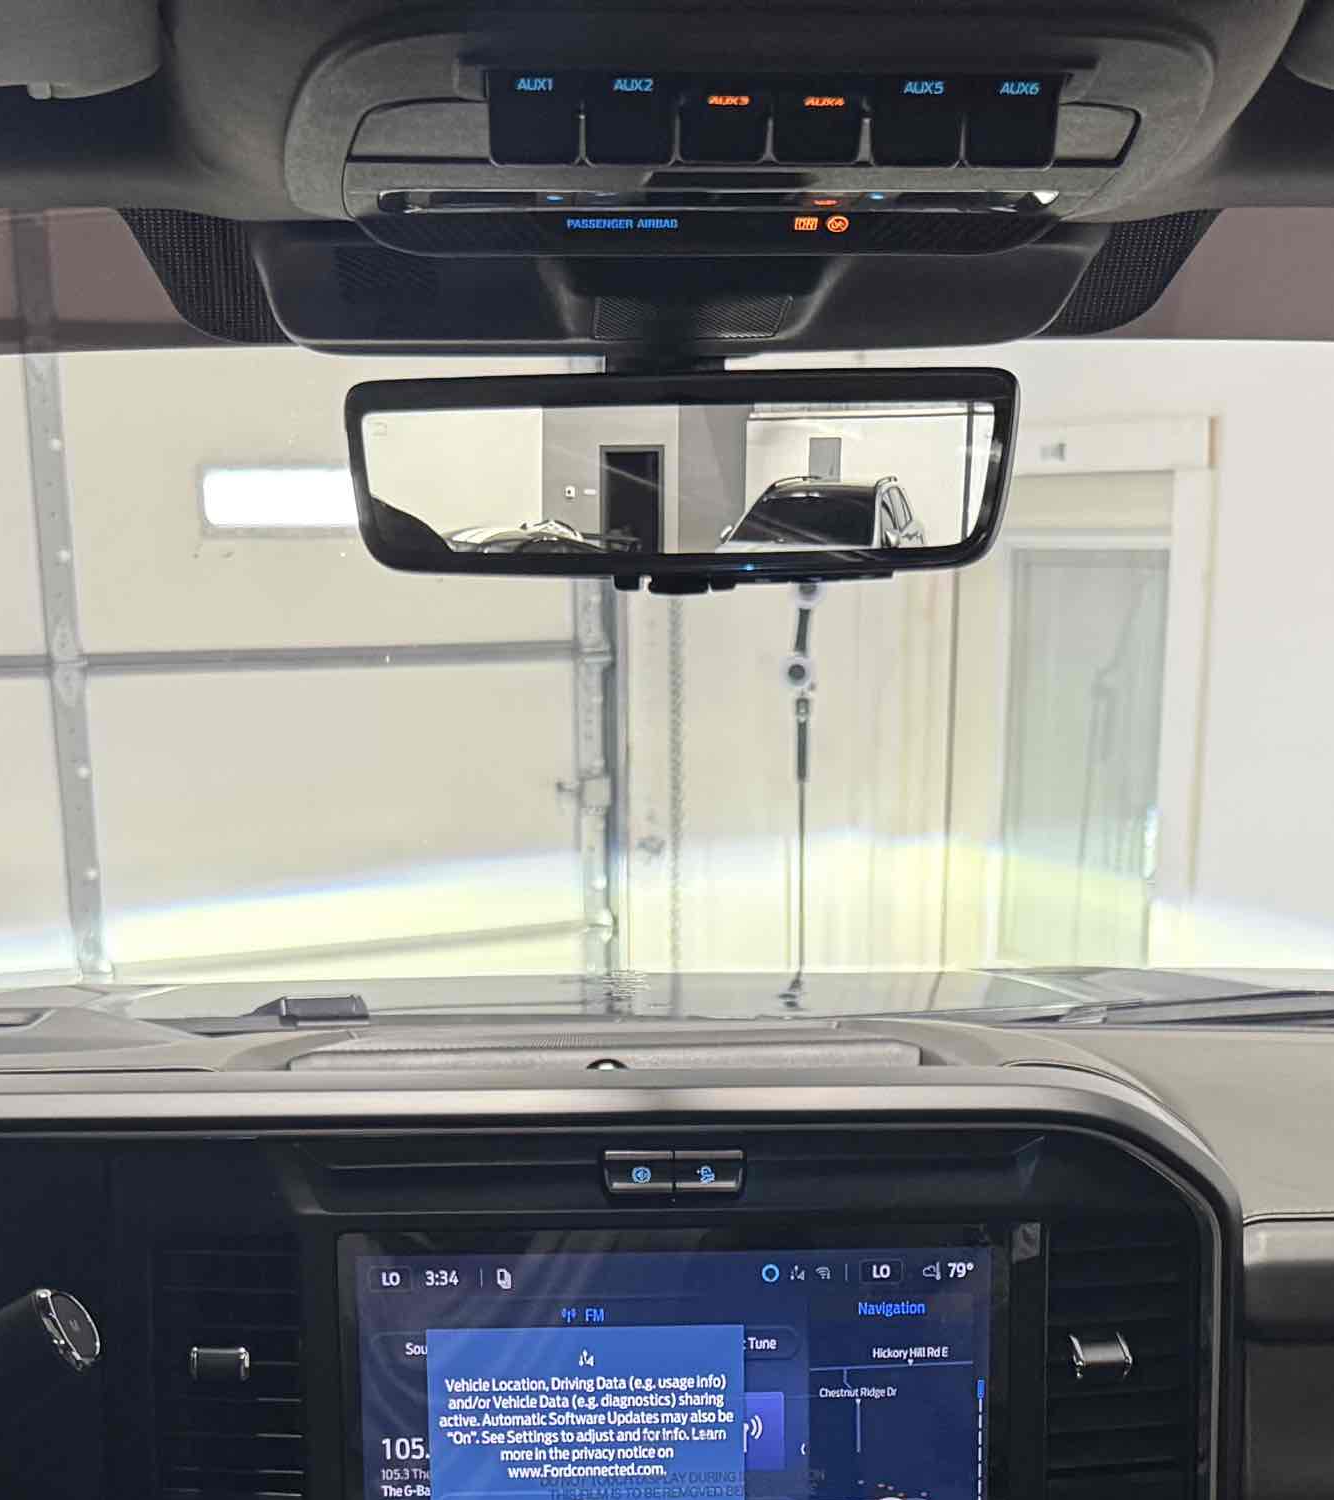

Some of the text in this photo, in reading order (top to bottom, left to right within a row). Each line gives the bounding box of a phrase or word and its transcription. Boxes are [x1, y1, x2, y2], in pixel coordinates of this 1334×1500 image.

[517, 78, 554, 92] AUX1
[613, 78, 654, 92] AUX2
[903, 81, 944, 94] AUX5
[999, 81, 1039, 96] AUX6
[708, 95, 750, 106] AUX3
[803, 96, 845, 107] AUX4
[566, 218, 678, 230] PASSENGER AIRBAG
[425, 1270, 459, 1287] 3:34
[872, 1264, 890, 1279] LO
[382, 1272, 401, 1286] LO
[585, 1308, 604, 1323] FM
[858, 1301, 925, 1317] Navigation
[748, 1336, 777, 1350] Tune
[873, 1347, 948, 1360] Hickory Hill Rd E
[444, 1374, 726, 1393] Vehicle Location, Driving Data (e.g. usage info)
[819, 1387, 859, 1398] Chestnut
[886, 1387, 897, 1397] Dr
[448, 1392, 725, 1411] and/or Vehicle Data (e.g. diagnostics) sharing
[439, 1409, 734, 1428] active. Automatic Software Updates may also be
[482, 1430, 507, 1444] See
[509, 1429, 559, 1446] Settings
[561, 1429, 574, 1443] to
[576, 1428, 615, 1446] adjust
[616, 1428, 641, 1442] and
[642, 1427, 660, 1441] for
[662, 1427, 690, 1441] info.
[691, 1427, 726, 1441] Learn
[500, 1446, 674, 1464] more in the privacy notice on
[381, 1469, 410, 1481] 105.3
[507, 1463, 667, 1479] www.Fordconnected.com.
[381, 1485, 403, 1497] The
